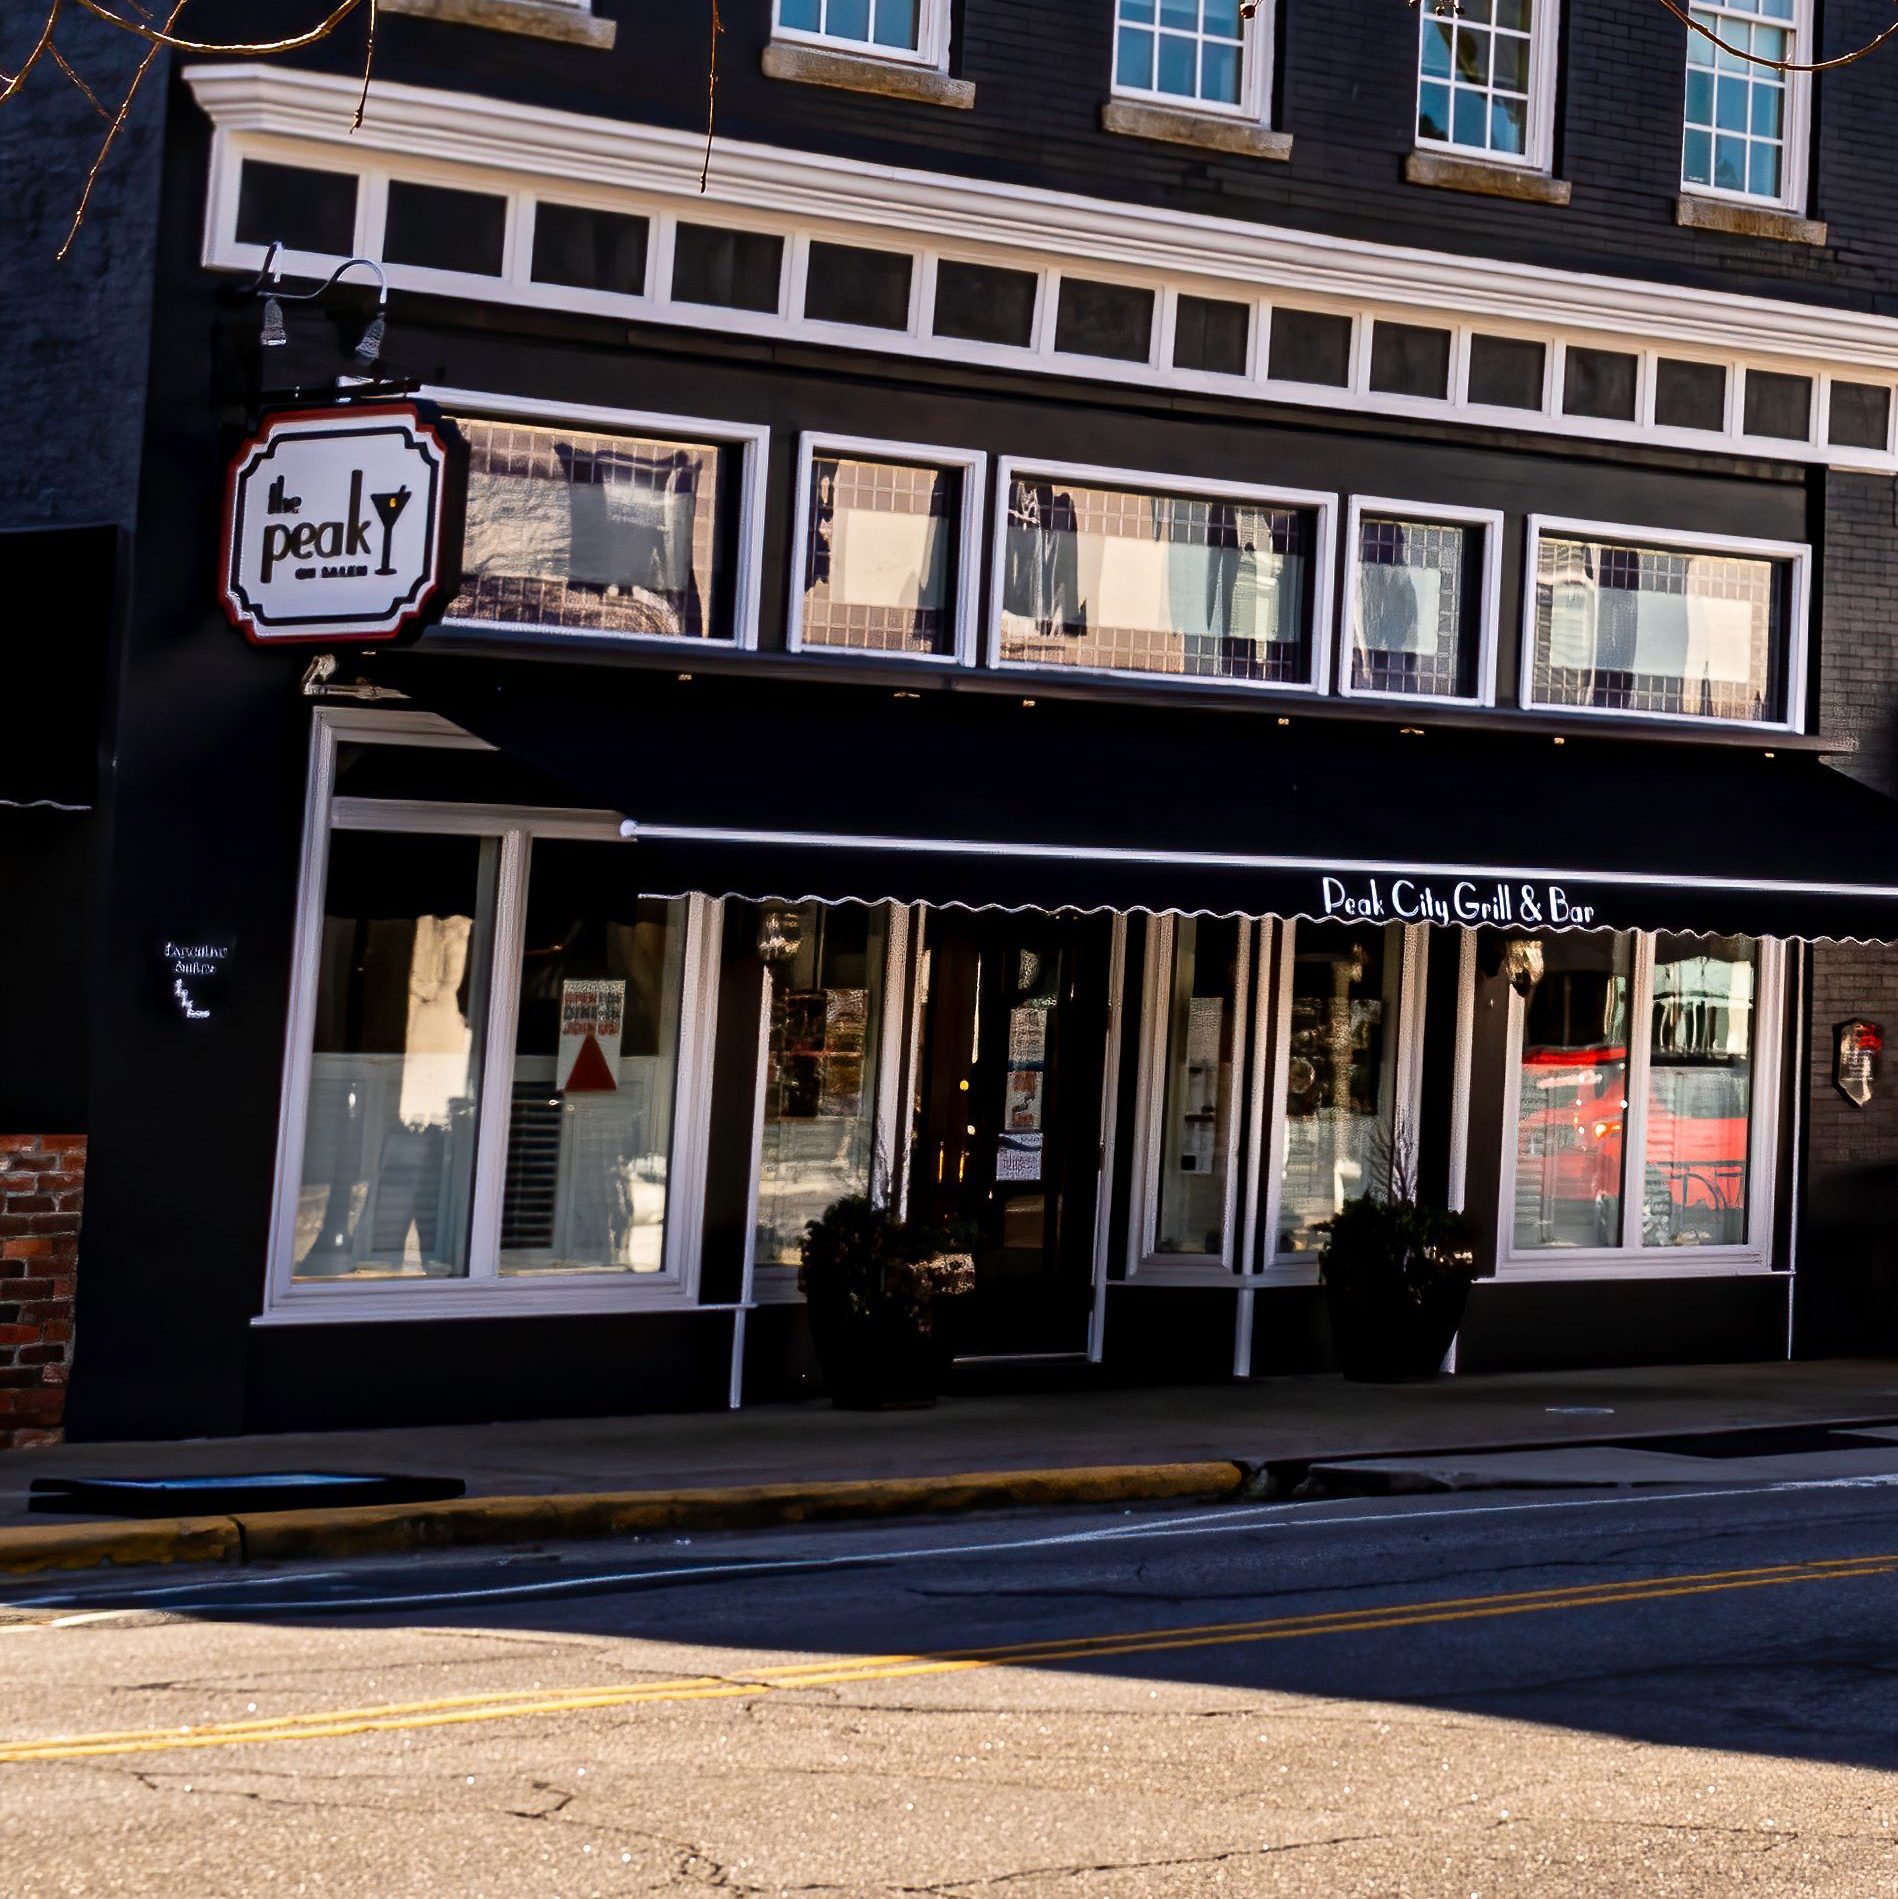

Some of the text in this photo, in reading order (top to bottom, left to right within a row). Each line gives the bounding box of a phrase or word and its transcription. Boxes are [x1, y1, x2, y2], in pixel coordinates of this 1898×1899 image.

[267, 475, 302, 515] the
[260, 469, 372, 584] peak
[1322, 876, 1594, 925] Peak City Grill & Bar
